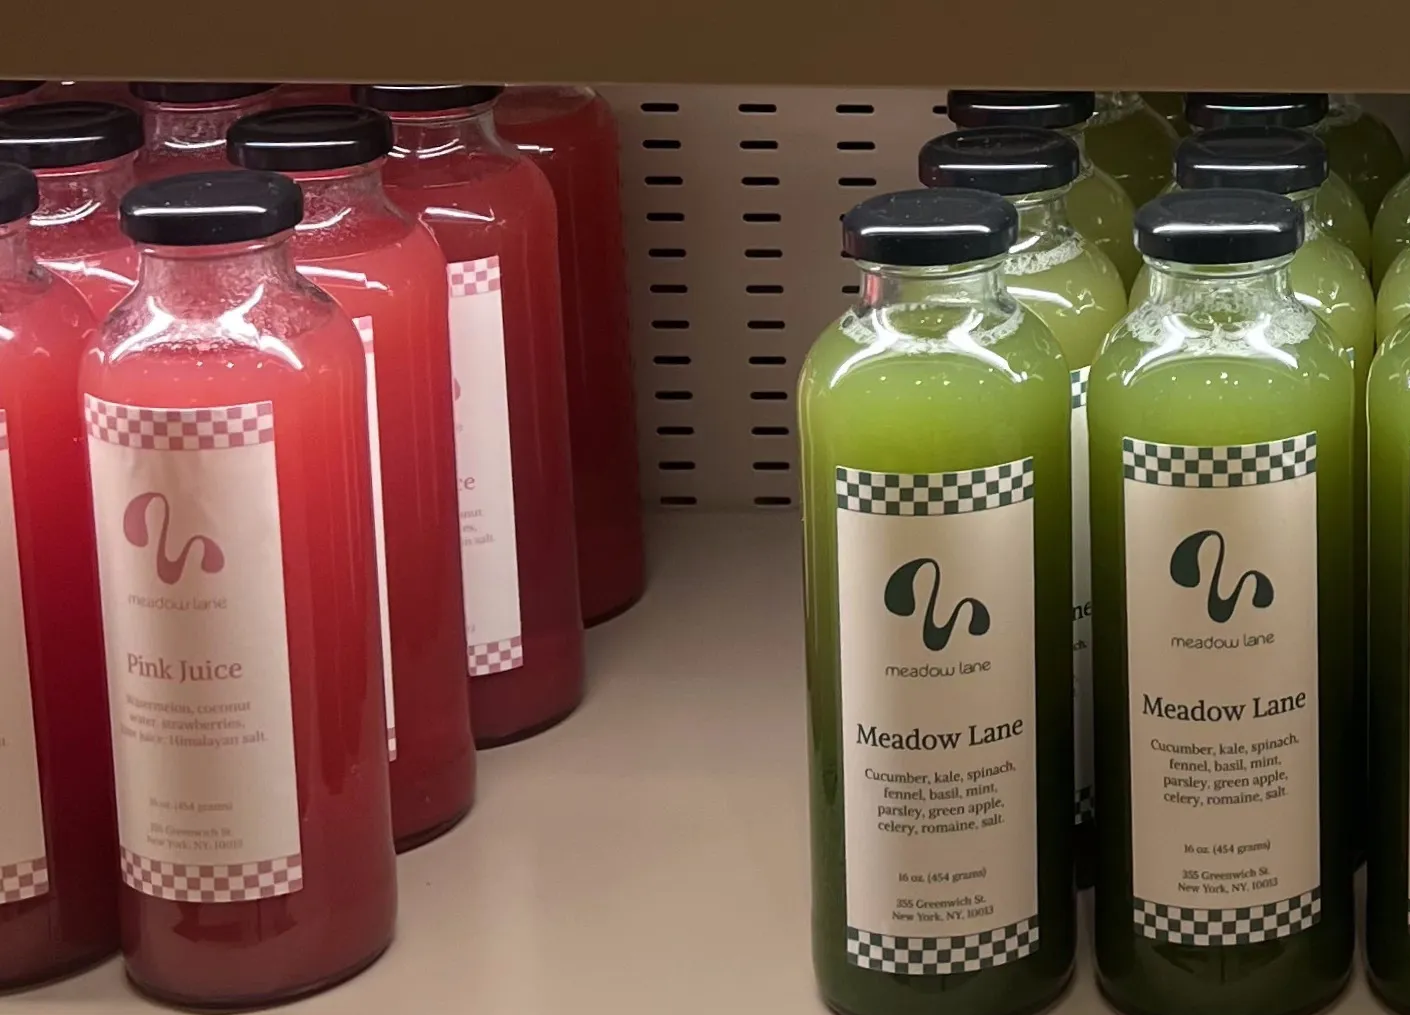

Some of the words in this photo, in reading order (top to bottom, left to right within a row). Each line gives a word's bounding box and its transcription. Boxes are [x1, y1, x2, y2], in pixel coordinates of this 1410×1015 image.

[1171, 636, 1239, 649] meadow
[1243, 633, 1275, 647] lane
[127, 653, 173, 680] Pink
[179, 660, 242, 683] Juice
[885, 664, 955, 677] meadow
[959, 661, 991, 674] lane
[1143, 694, 1246, 721] Meadow
[1253, 691, 1306, 718] Lane
[856, 723, 961, 750] Meadow
[968, 719, 1023, 746] Lane
[1151, 738, 1216, 756] Cucumber,
[1219, 743, 1248, 755] kale,
[1251, 733, 1299, 754] spinach,
[865, 768, 931, 784] Cucumber,
[934, 770, 963, 783] kale,
[967, 761, 1016, 782] spinach,
[1169, 759, 1211, 773] fennel,
[1214, 759, 1247, 772] basil,
[1250, 755, 1281, 769] mint,
[1163, 775, 1210, 791] parsley,
[1214, 778, 1249, 790] green
[1253, 769, 1288, 786] apple,
[884, 787, 925, 801] fennel,
[930, 787, 962, 799] basil,
[966, 783, 997, 796] mint,
[1163, 792, 1203, 807] celery,
[1207, 795, 1262, 805] romaine,
[878, 805, 925, 819] parsley,
[928, 806, 964, 819] green
[968, 797, 1004, 814] apple,
[878, 820, 918, 836] celery,
[921, 819, 978, 833] romaine,
[899, 873, 908, 882] 16
[927, 873, 949, 884] (454
[952, 867, 986, 883] grams)
